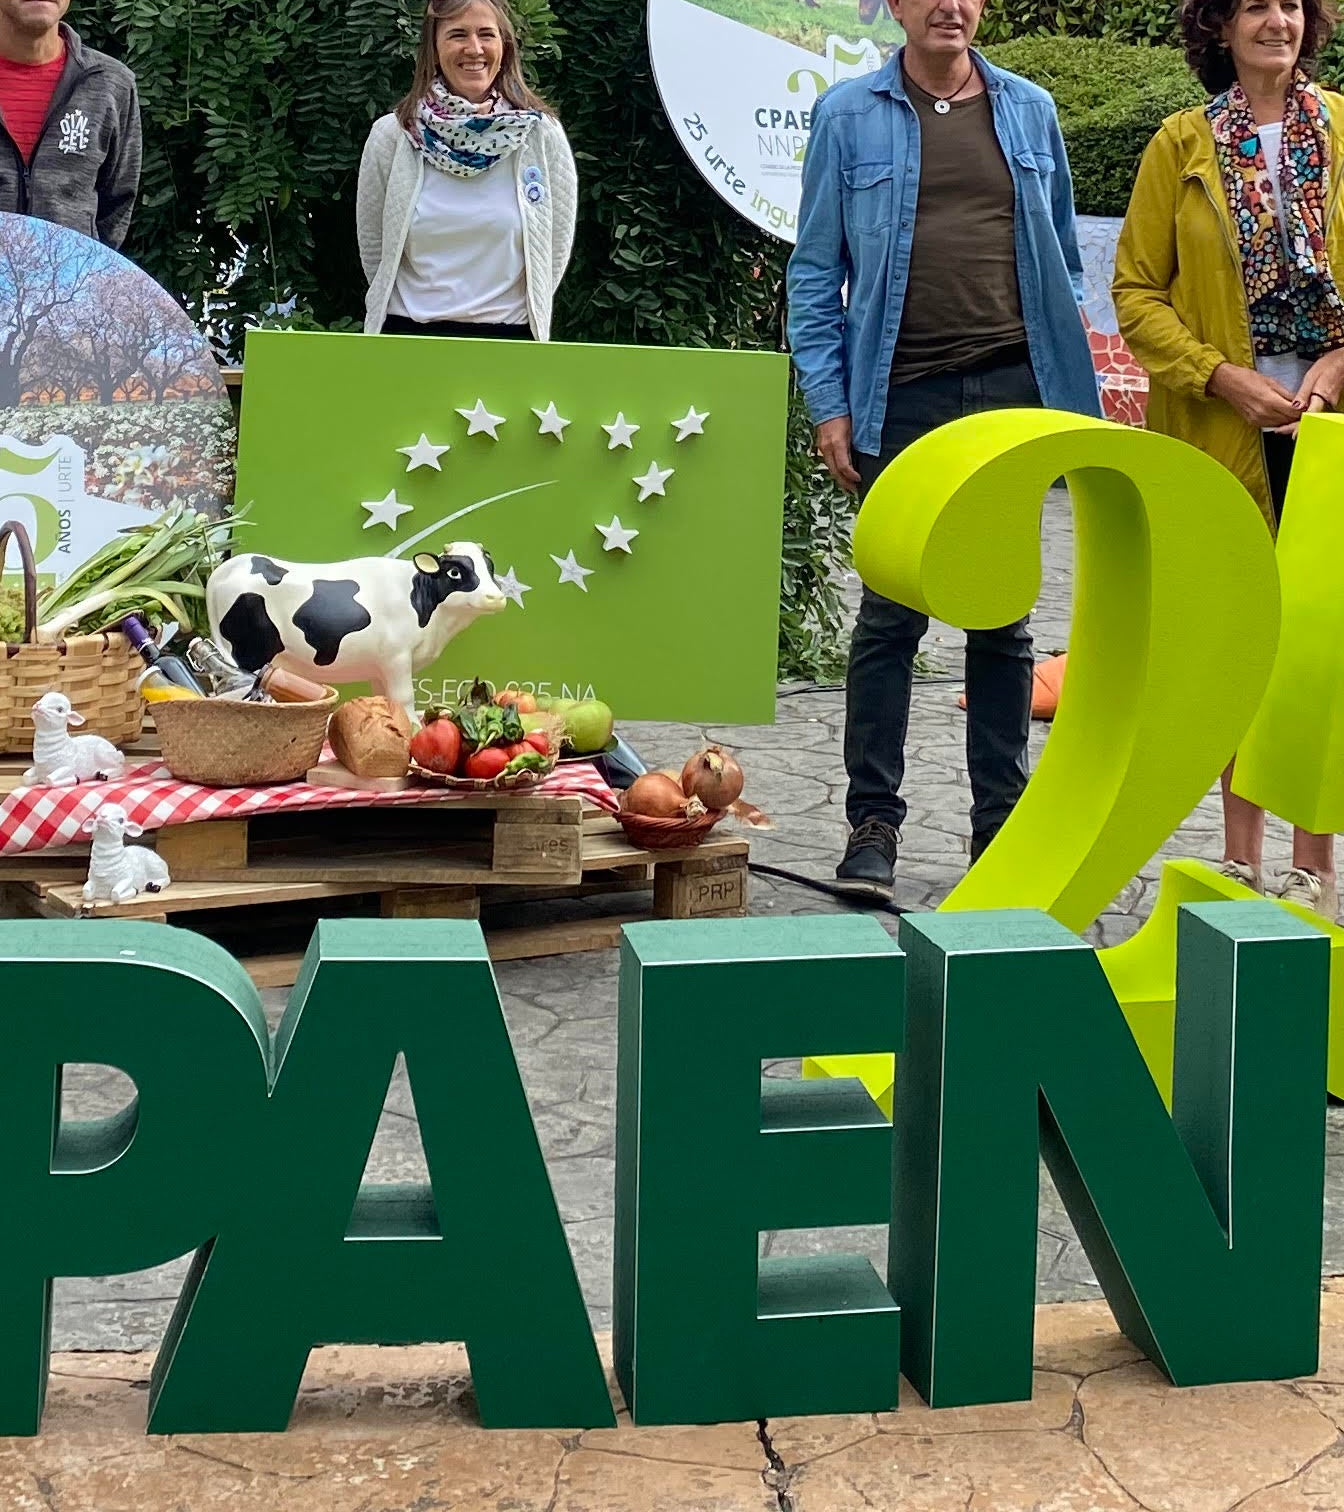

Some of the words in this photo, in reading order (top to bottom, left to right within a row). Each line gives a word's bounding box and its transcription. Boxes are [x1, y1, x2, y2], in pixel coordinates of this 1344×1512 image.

[755, 107, 811, 130] CPAE
[758, 134, 809, 157] NNP
[683, 112, 709, 142] 25
[705, 145, 746, 195] urte
[750, 190, 797, 229] ingu
[58, 455, 72, 492] URTE
